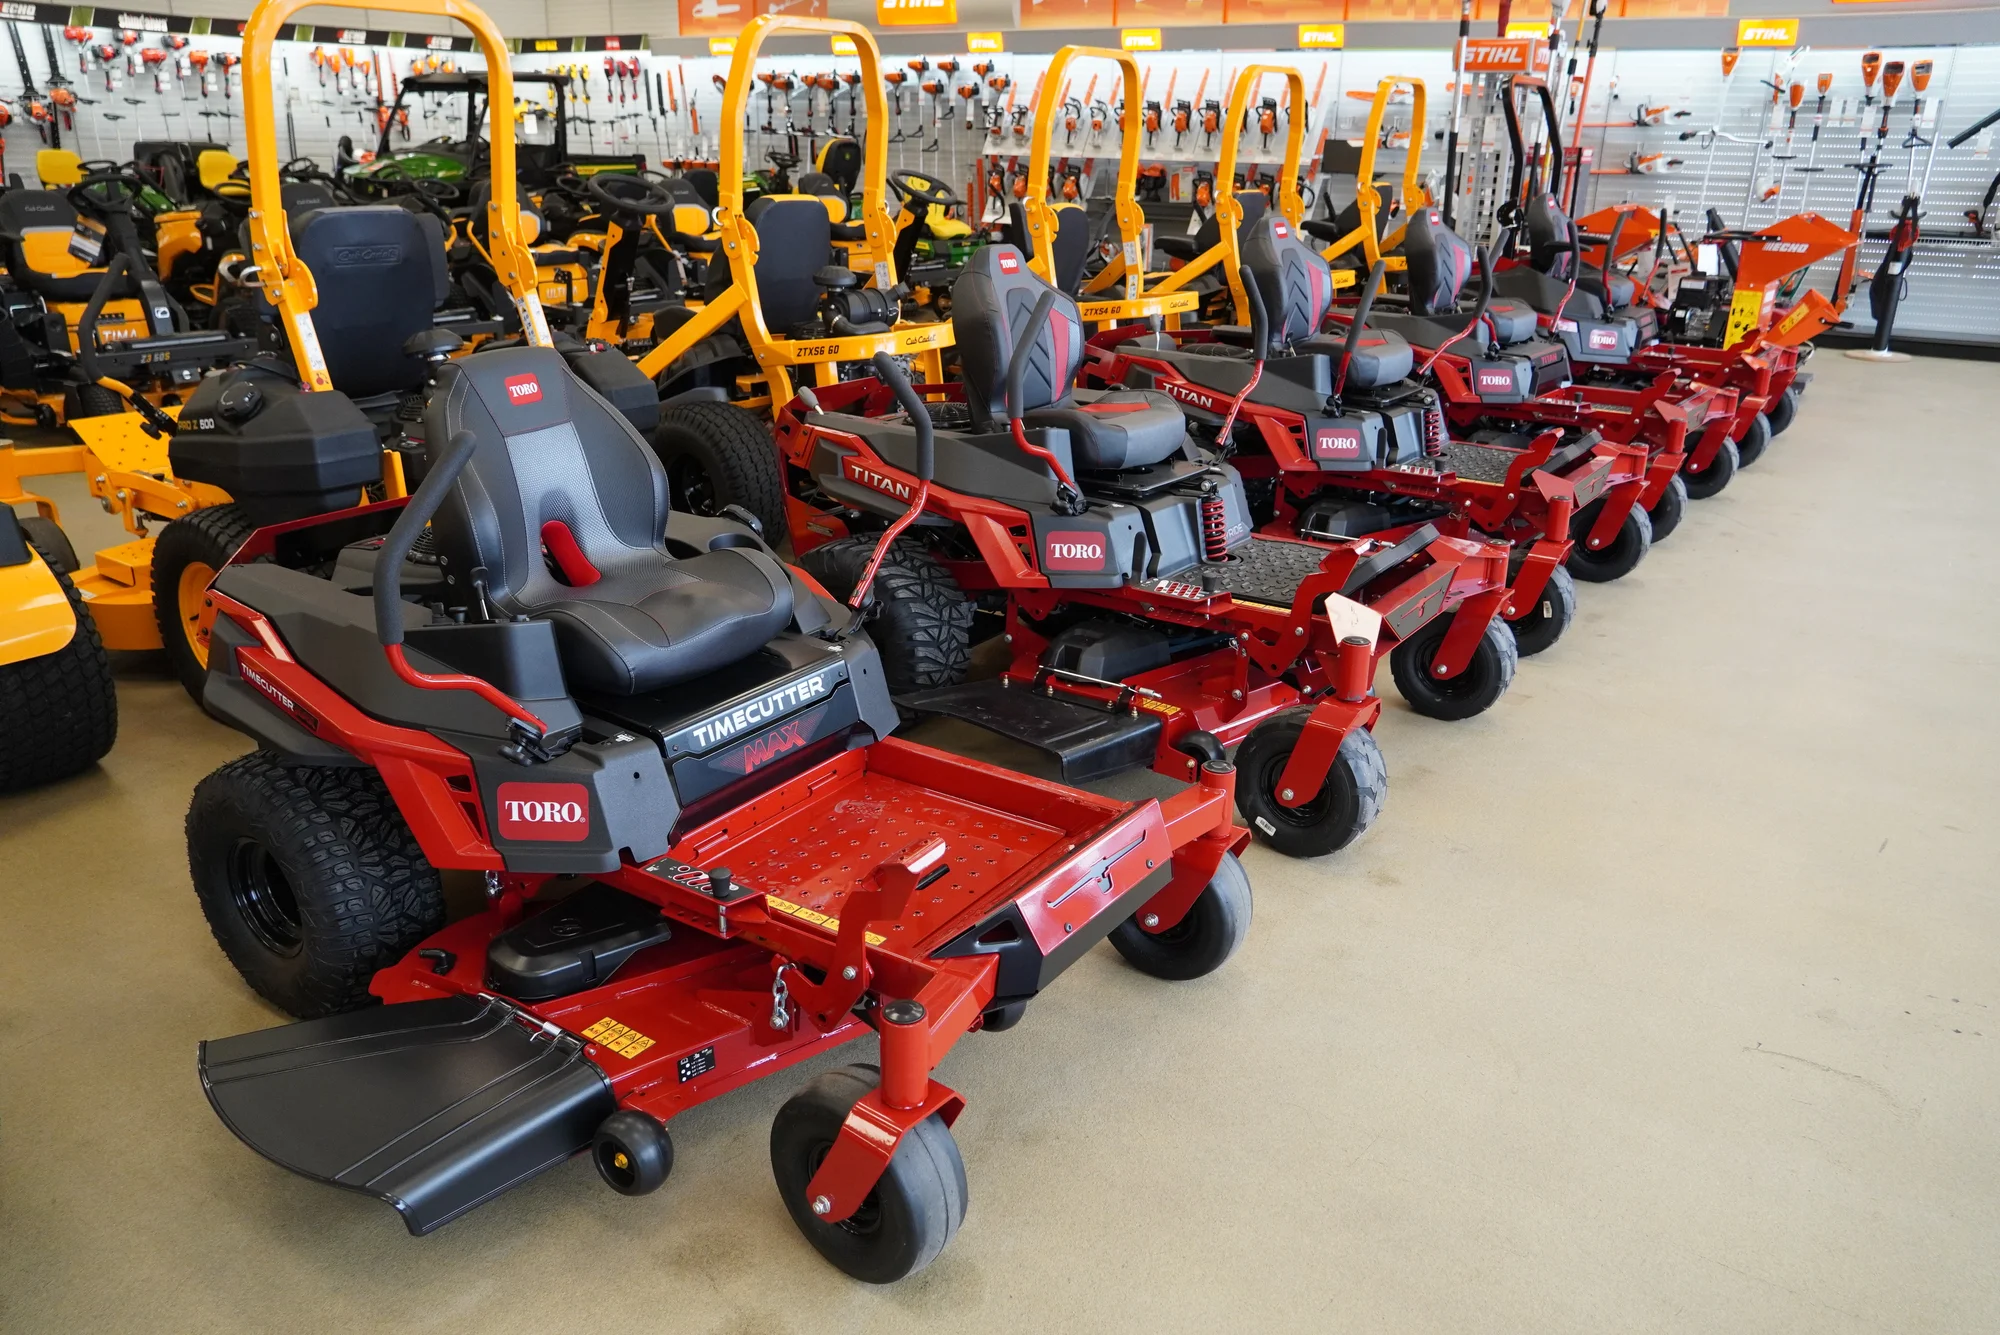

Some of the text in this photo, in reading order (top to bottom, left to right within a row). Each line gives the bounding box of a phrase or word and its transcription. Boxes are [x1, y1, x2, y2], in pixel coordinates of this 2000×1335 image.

[2, 2, 36, 16] ECHO
[1303, 32, 1336, 43] STIHL
[1743, 28, 1789, 41] STIHL
[1464, 46, 1523, 63] STIHL
[1773, 242, 1809, 254] ECHO
[1000, 258, 1018, 269] TORO
[1084, 306, 1121, 317] ZTXS4 60
[905, 337, 918, 346] Cub
[1591, 335, 1617, 346] TORO
[796, 344, 840, 358] ZTXS6 60
[1480, 375, 1511, 387] TORO
[509, 382, 539, 398] TORO
[1162, 382, 1213, 408] TITAN
[193, 420, 199, 430] Z
[199, 418, 215, 430] 500
[1319, 437, 1358, 449] TORO
[851, 464, 910, 499] TITAN
[1051, 543, 1103, 559] TORO
[241, 662, 295, 712] TIMECUTTER
[692, 673, 826, 747] TIMECUTTER
[743, 720, 807, 774] MAX
[505, 800, 583, 823] TORO
